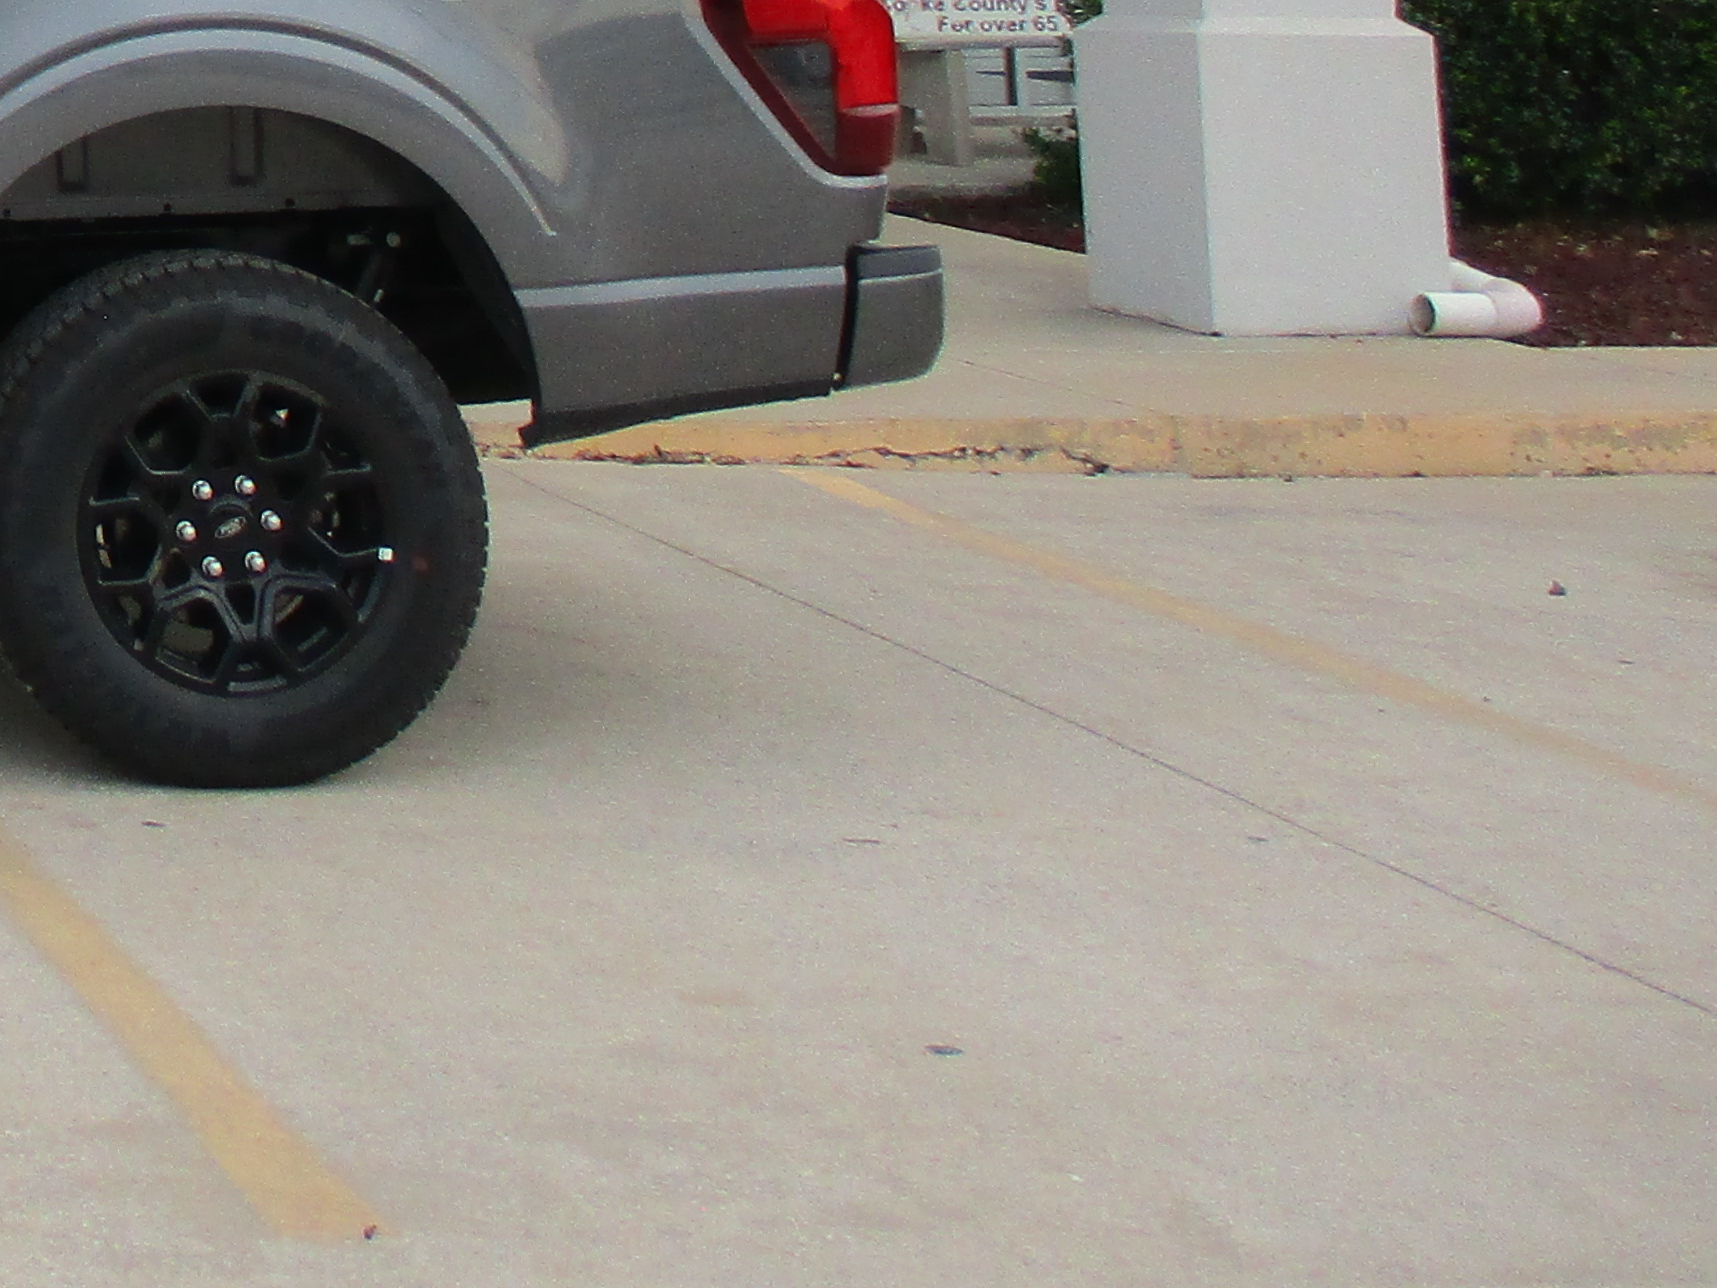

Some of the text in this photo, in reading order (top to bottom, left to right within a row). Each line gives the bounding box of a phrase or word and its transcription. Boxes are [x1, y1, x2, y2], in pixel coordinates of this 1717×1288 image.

[937, 14, 1058, 32] For over 65
